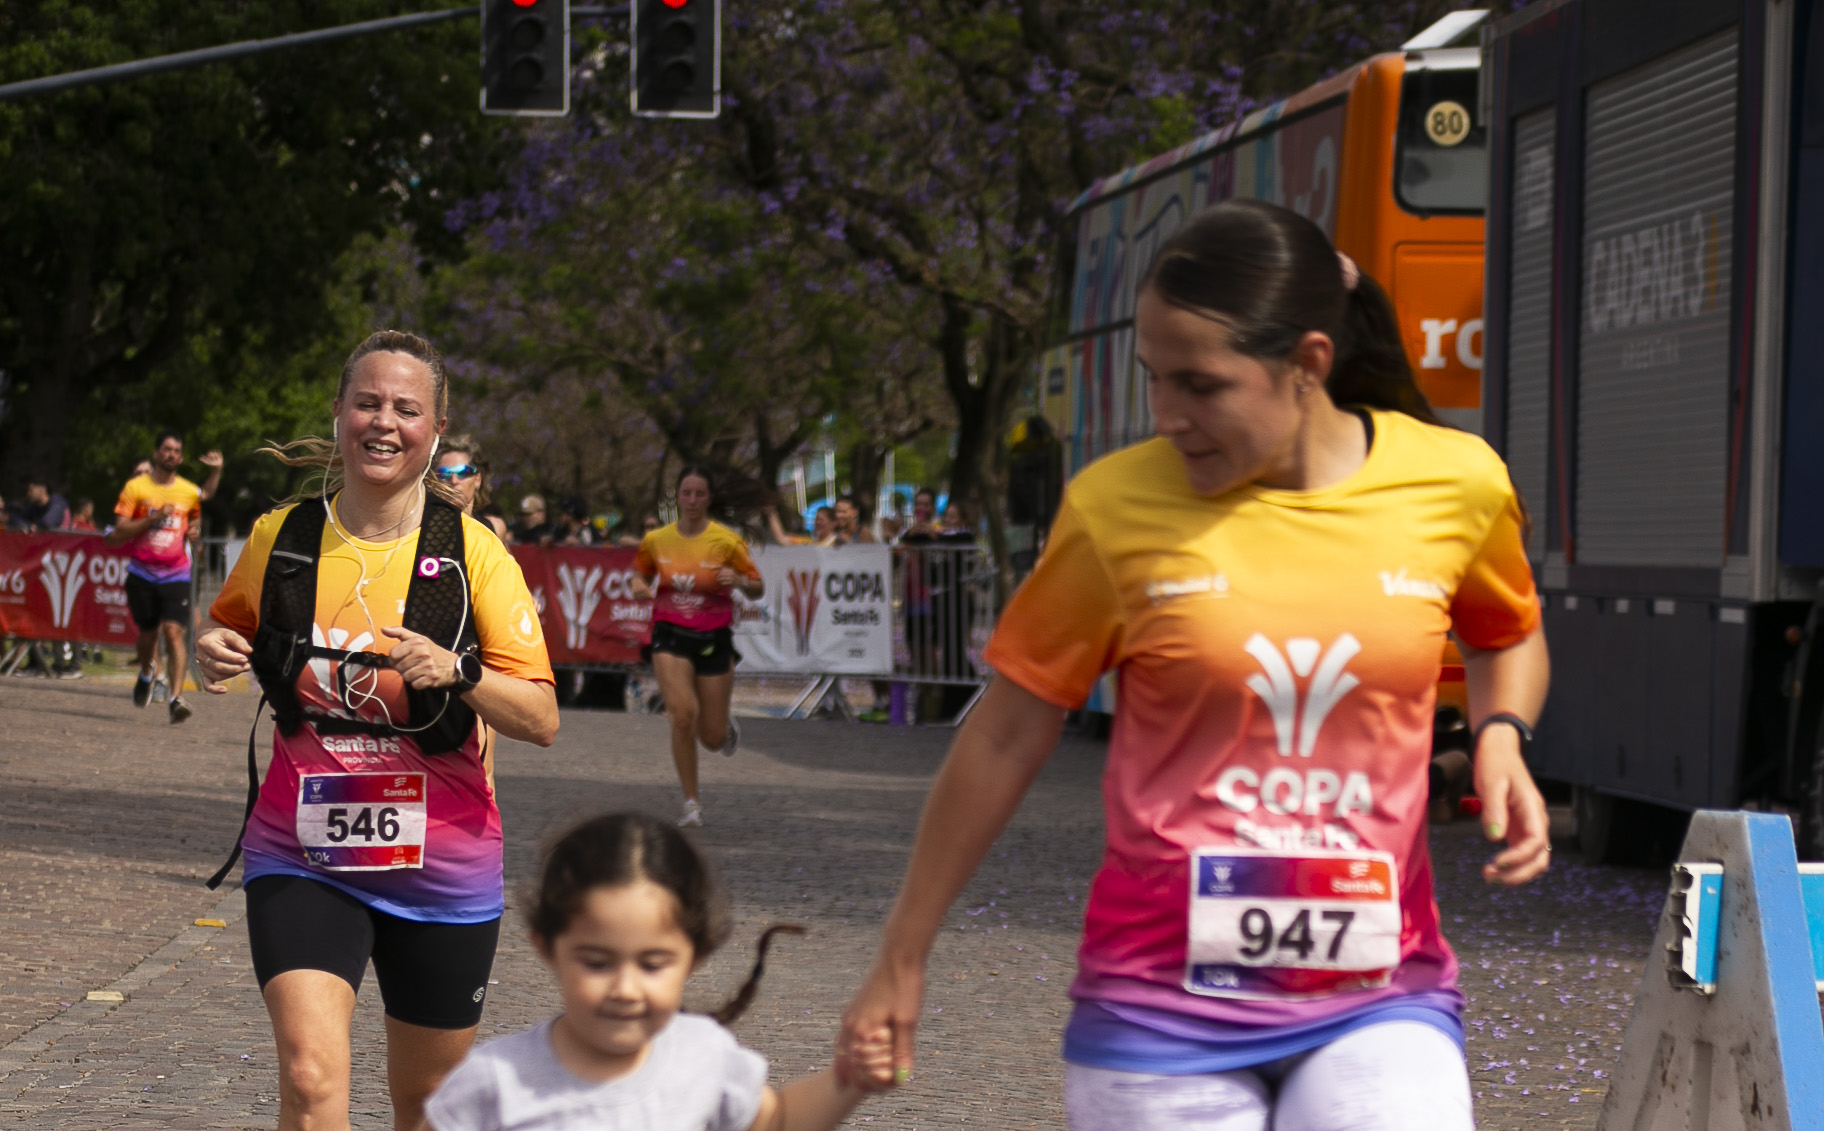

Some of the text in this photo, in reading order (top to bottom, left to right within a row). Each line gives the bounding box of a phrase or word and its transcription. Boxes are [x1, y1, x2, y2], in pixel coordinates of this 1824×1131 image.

[1432, 112, 1462, 136] 80
[89, 555, 130, 586] COP
[826, 571, 885, 602] COPA
[322, 736, 378, 753] Santa
[1216, 765, 1373, 818] COPA
[326, 807, 400, 843] 546
[1239, 908, 1356, 962] 947
